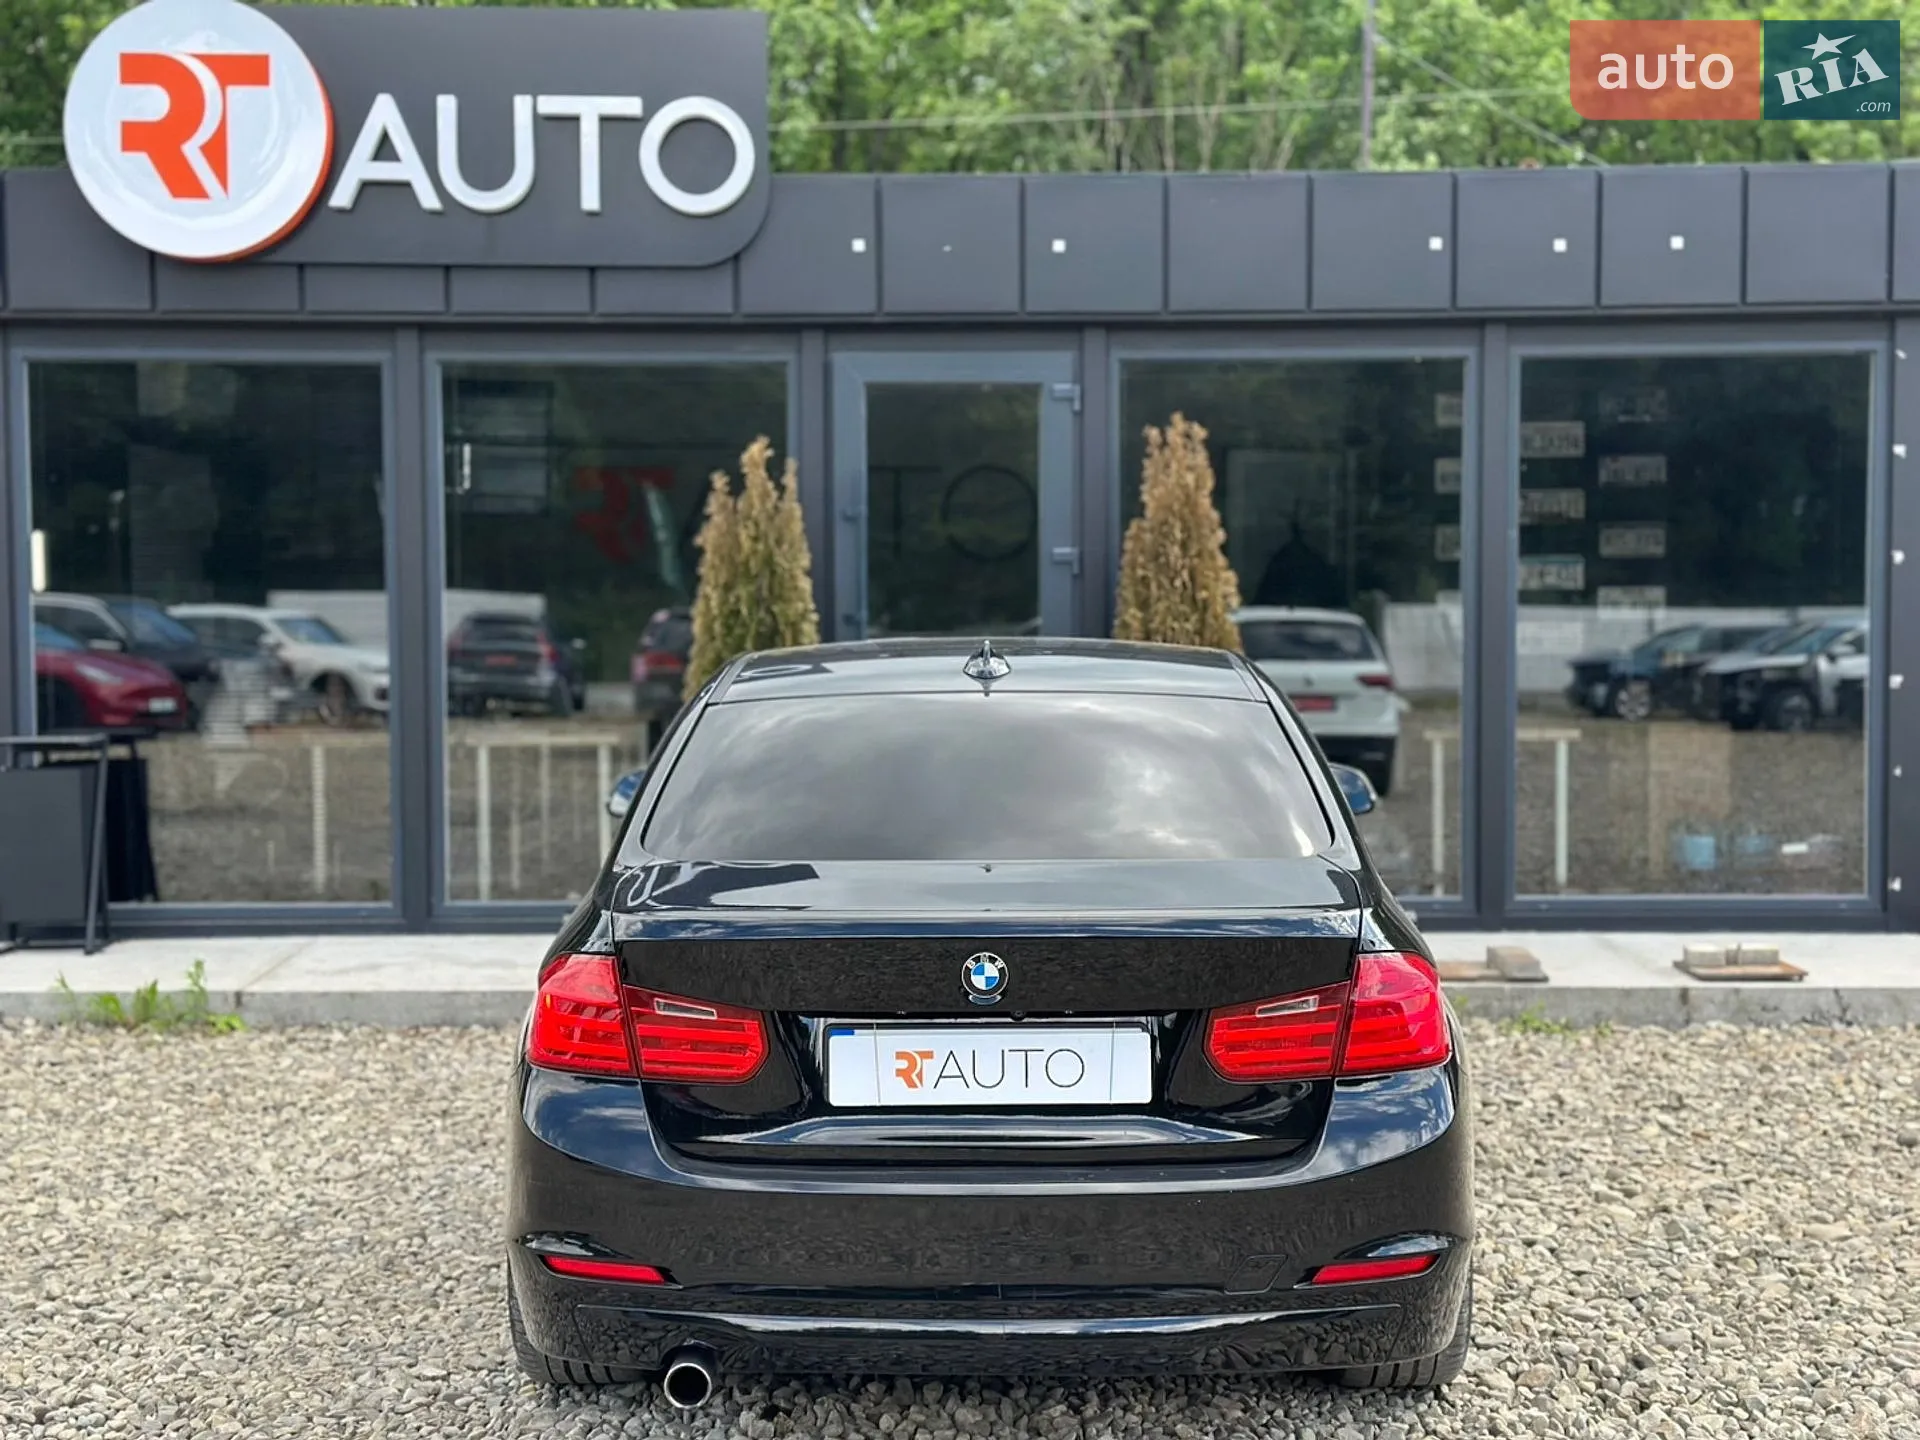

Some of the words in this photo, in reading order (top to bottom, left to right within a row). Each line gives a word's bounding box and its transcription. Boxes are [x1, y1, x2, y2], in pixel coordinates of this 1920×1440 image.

[119, 52, 270, 201] RT
[328, 93, 756, 216] AUTO
[894, 1050, 934, 1089] RT
[933, 1048, 1086, 1090] AUTO
